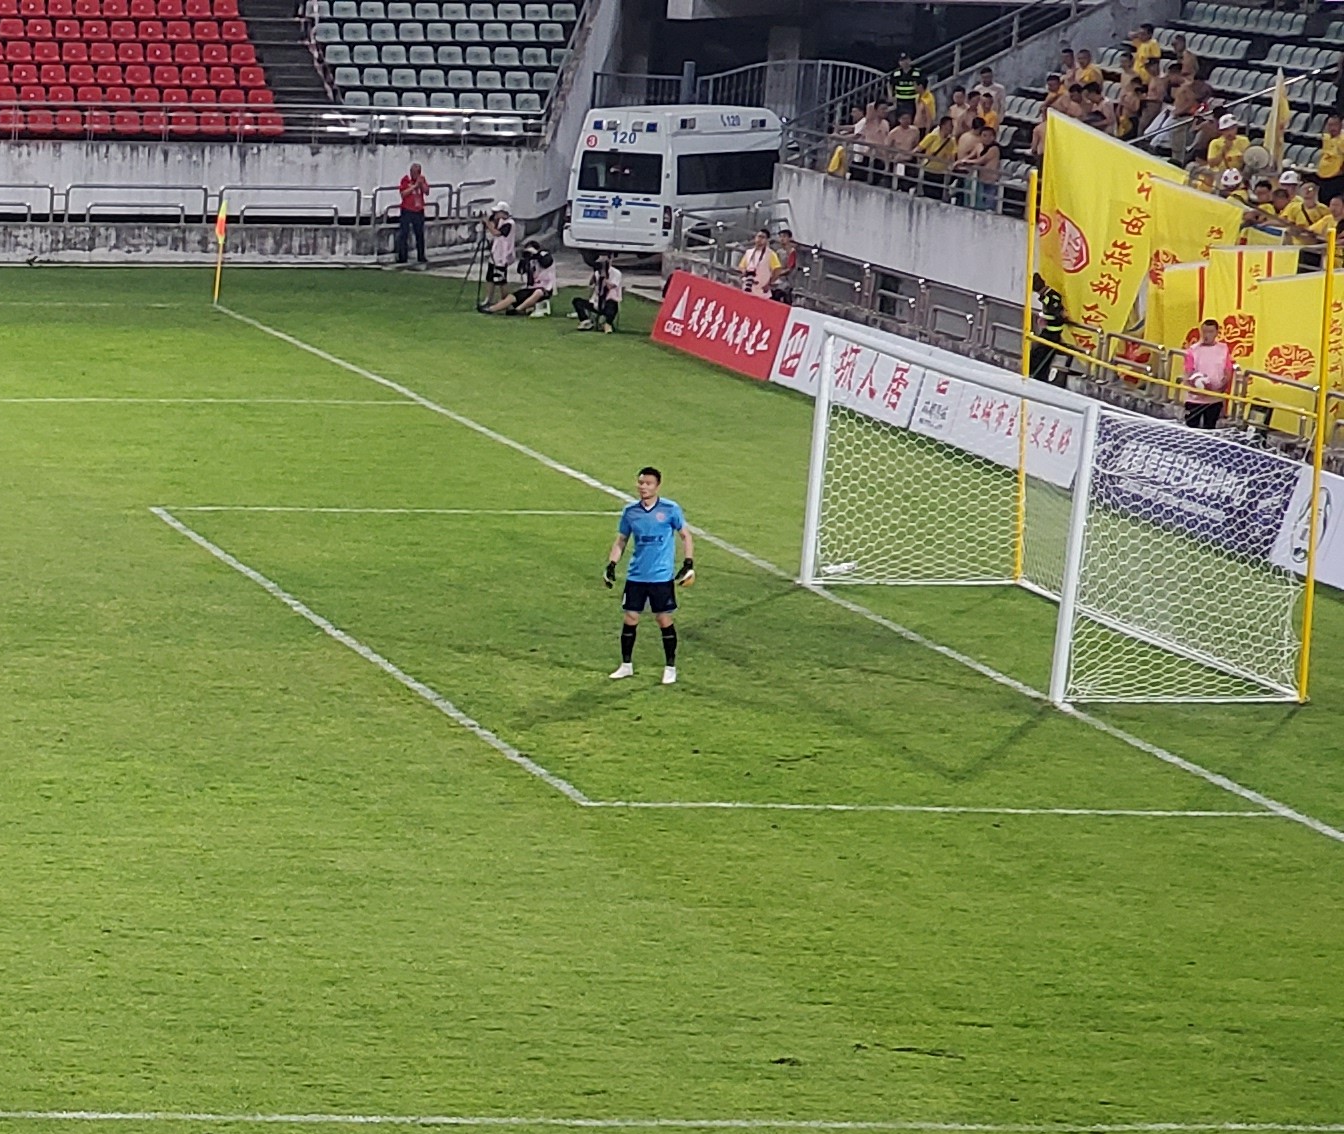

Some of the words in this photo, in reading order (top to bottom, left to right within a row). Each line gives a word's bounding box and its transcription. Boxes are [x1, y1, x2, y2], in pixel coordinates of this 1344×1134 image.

[612, 131, 637, 145] 120
[968, 395, 1073, 456] 让城市生更美好
